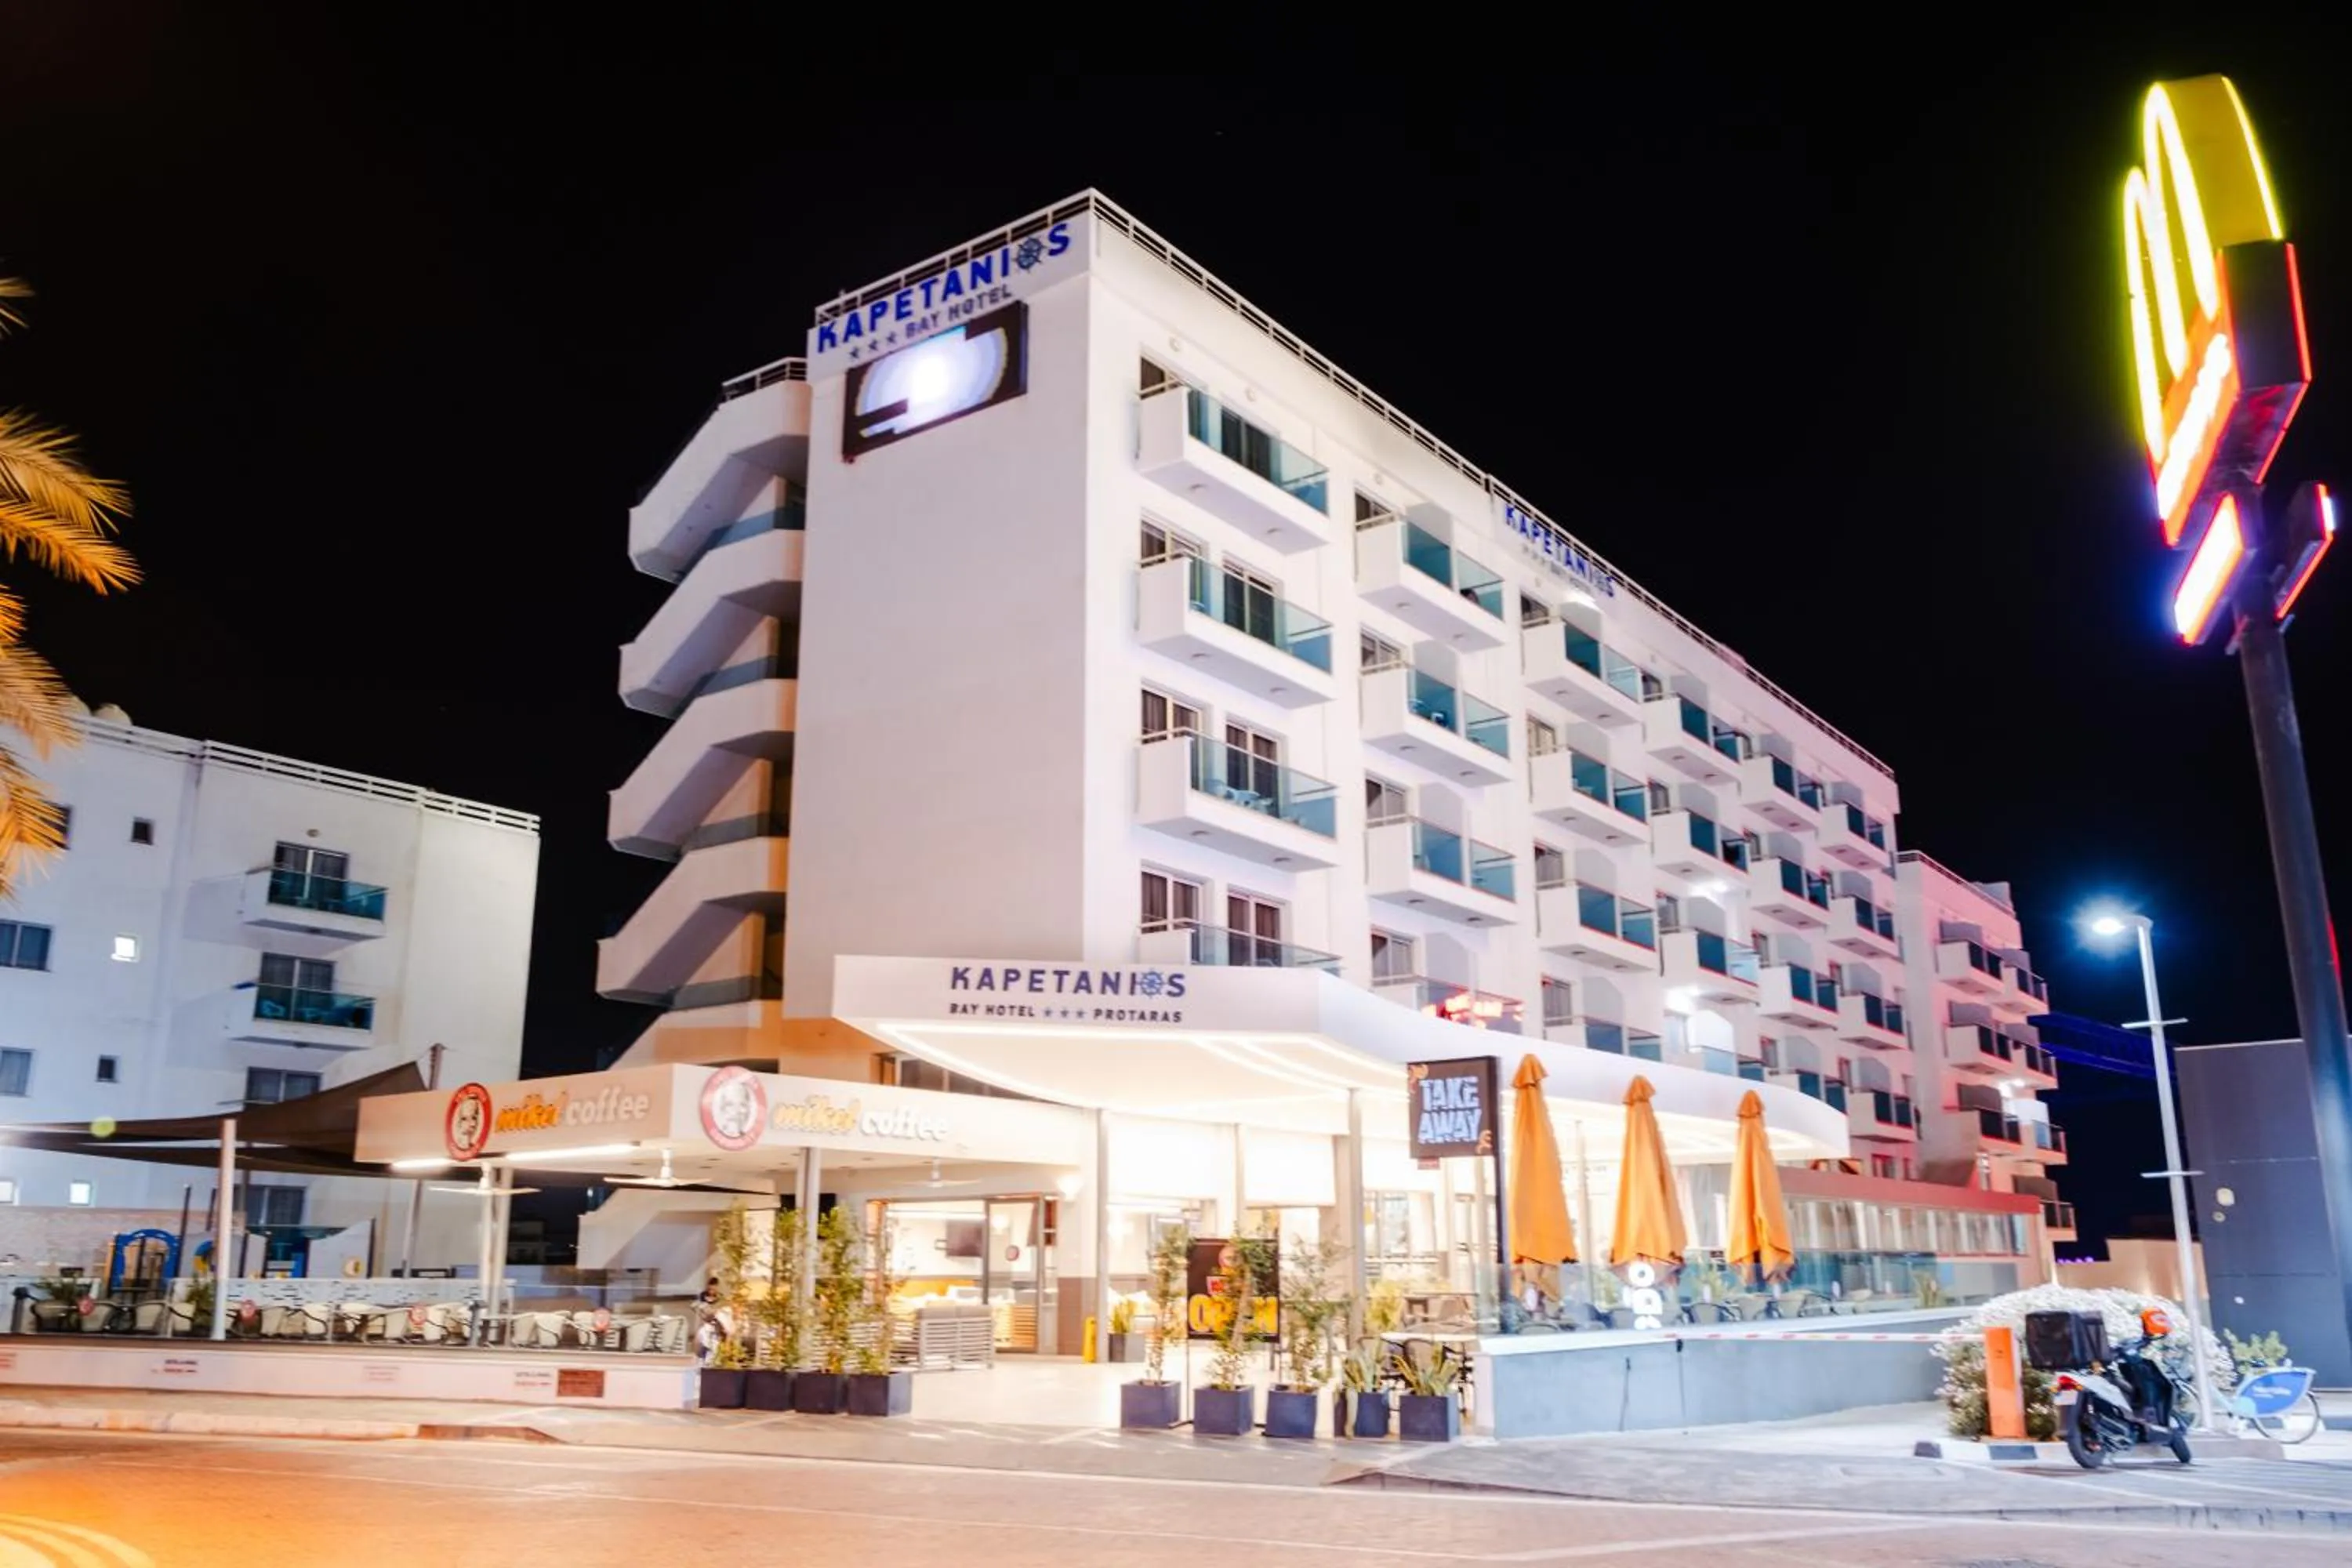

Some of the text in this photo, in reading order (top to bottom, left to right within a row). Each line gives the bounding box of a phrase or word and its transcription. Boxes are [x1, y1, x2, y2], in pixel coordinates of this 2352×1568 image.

[818, 223, 1071, 353] KAPETANIOS
[906, 283, 1014, 339] BAY HOTEL
[950, 967, 1186, 999] KAPETANIOS
[949, 1002, 1183, 1023] BAY HOTEL PROTARAS
[563, 1087, 650, 1127] coffee
[1418, 1076, 1479, 1112] TAKE
[860, 1105, 949, 1142] coffee
[1417, 1108, 1482, 1145] AWAY
[1189, 1293, 1279, 1336] OPN
